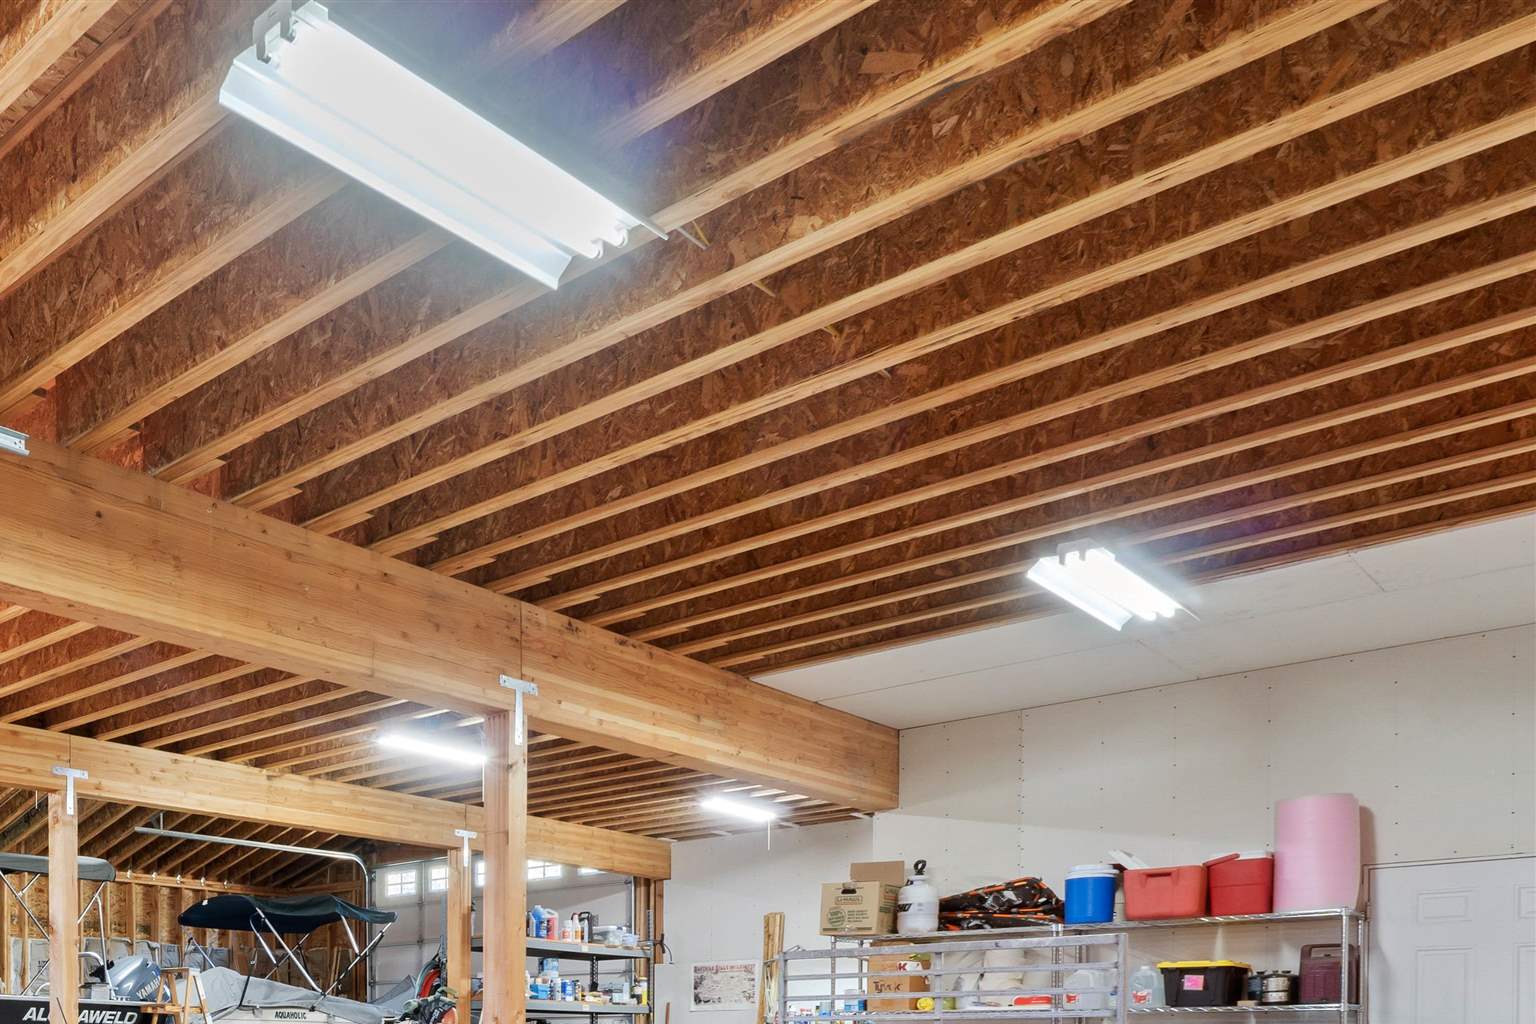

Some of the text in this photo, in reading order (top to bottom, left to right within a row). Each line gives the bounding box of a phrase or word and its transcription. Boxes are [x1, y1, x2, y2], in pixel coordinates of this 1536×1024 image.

[137, 976, 161, 1000] YAMAH
[22, 1007, 138, 1024] ALAWELD
[274, 1010, 307, 1020] AQUAHOLIC
